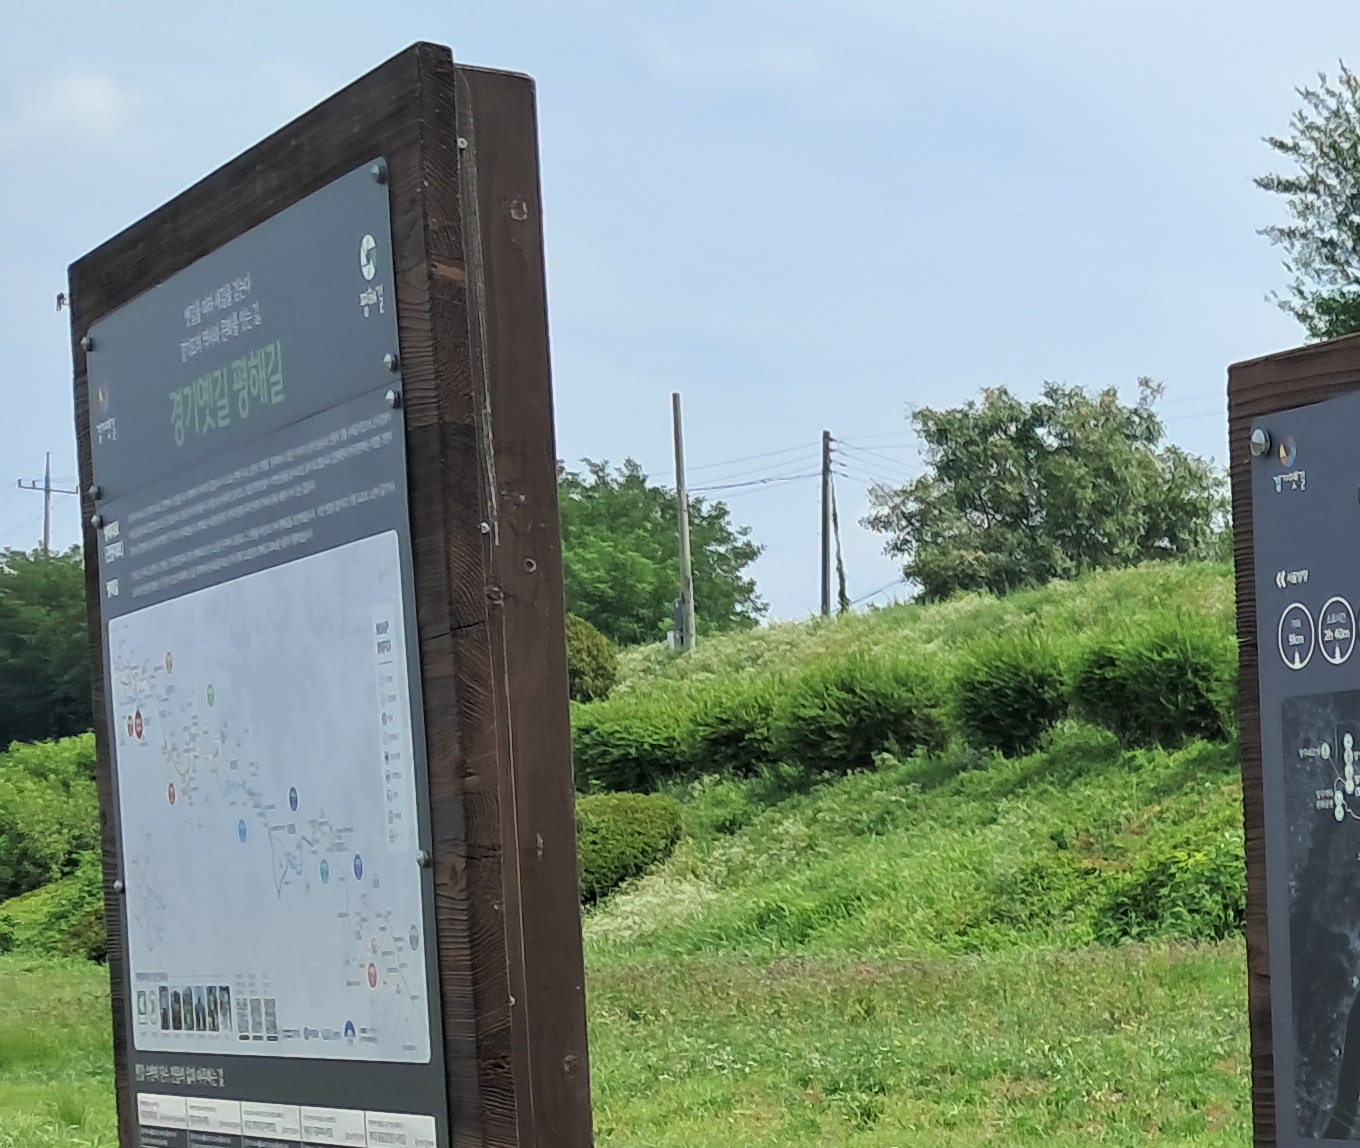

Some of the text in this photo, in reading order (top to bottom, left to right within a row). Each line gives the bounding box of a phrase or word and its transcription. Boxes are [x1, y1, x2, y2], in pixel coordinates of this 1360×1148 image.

[360, 284, 384, 318] 평해길
[168, 339, 285, 448] 경기옛길 평해길
